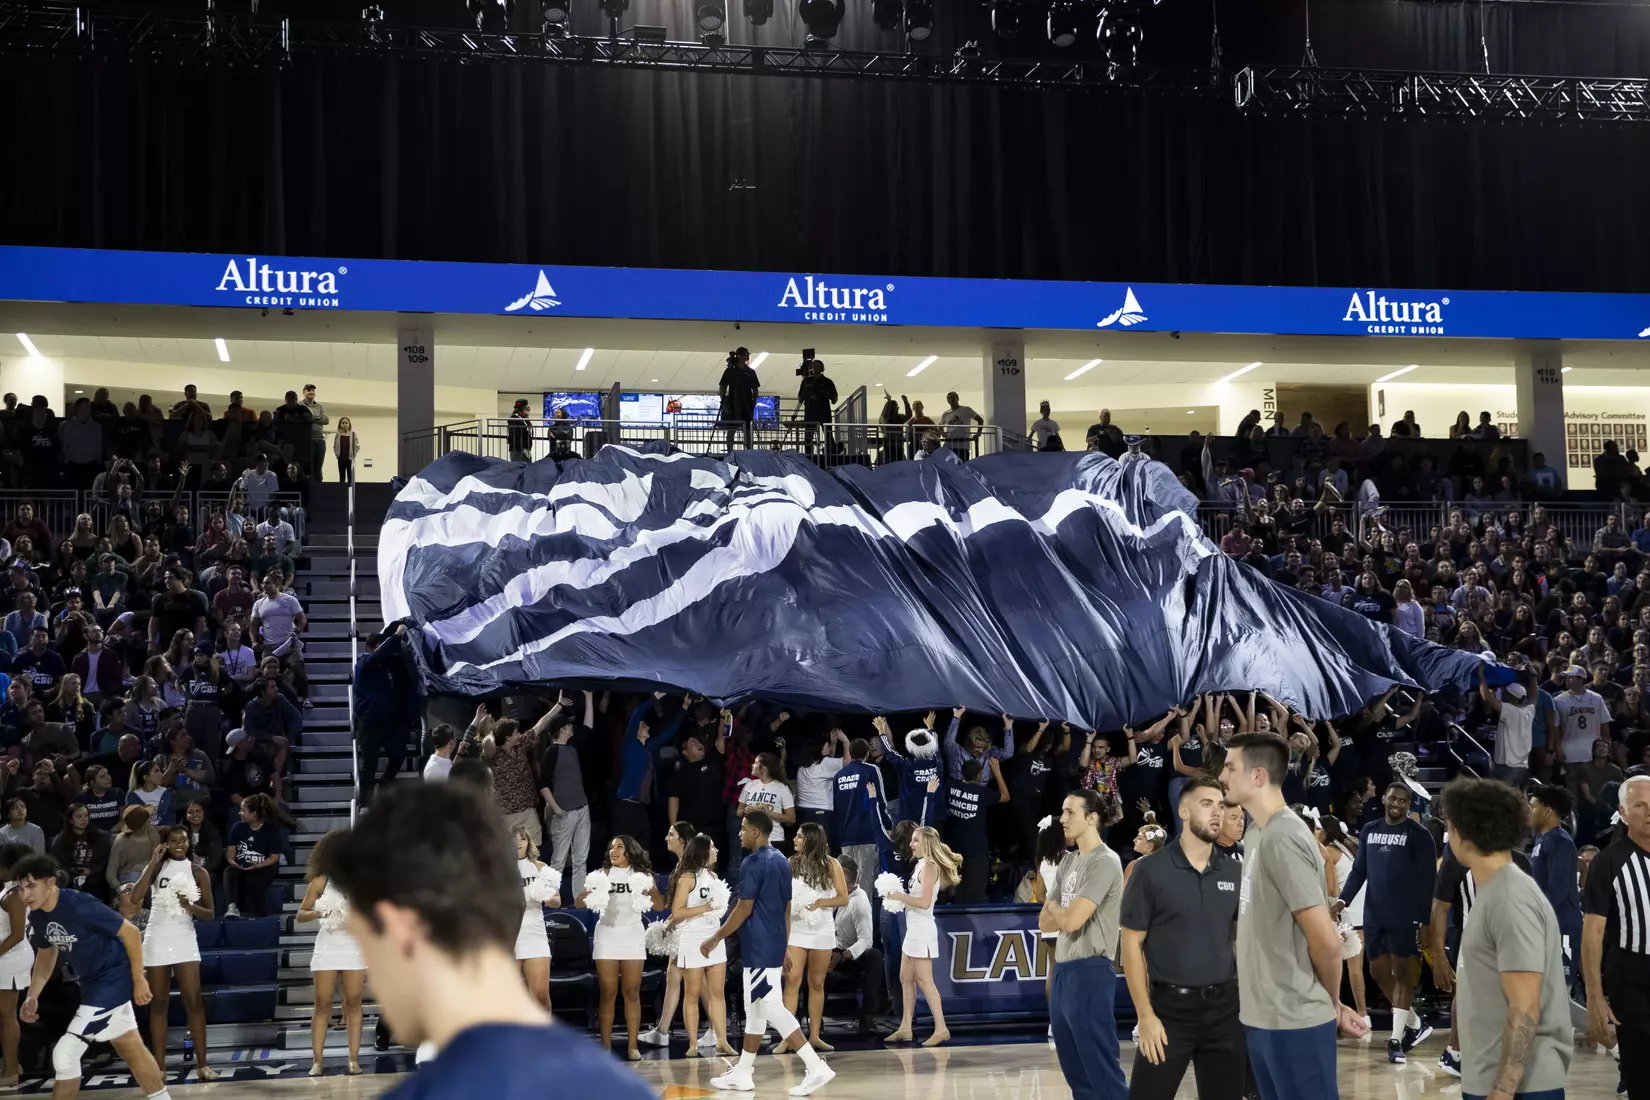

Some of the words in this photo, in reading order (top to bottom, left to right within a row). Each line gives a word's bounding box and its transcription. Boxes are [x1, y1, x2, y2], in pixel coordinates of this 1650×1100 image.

[245, 296, 293, 305] CREDIT
[299, 298, 339, 307] UNION
[804, 312, 846, 321] CREDIT
[852, 313, 888, 322] UNION
[1367, 325, 1406, 334] CREDIT
[1411, 326, 1444, 335] UNION
[408, 345, 425, 354] 108
[408, 354, 425, 364] 109
[1000, 358, 1017, 367] 109
[1001, 367, 1017, 376] 110
[1263, 388, 1275, 421] MEN
[1564, 411, 1599, 421] Advisory
[1601, 411, 1646, 420] Committee
[33, 676, 54, 685] CBU
[1578, 715, 1588, 730] 8
[950, 787, 961, 798] WE
[962, 792, 979, 802] ARE
[1367, 832, 1408, 847] AMBUSH
[1217, 881, 1235, 891] CBU
